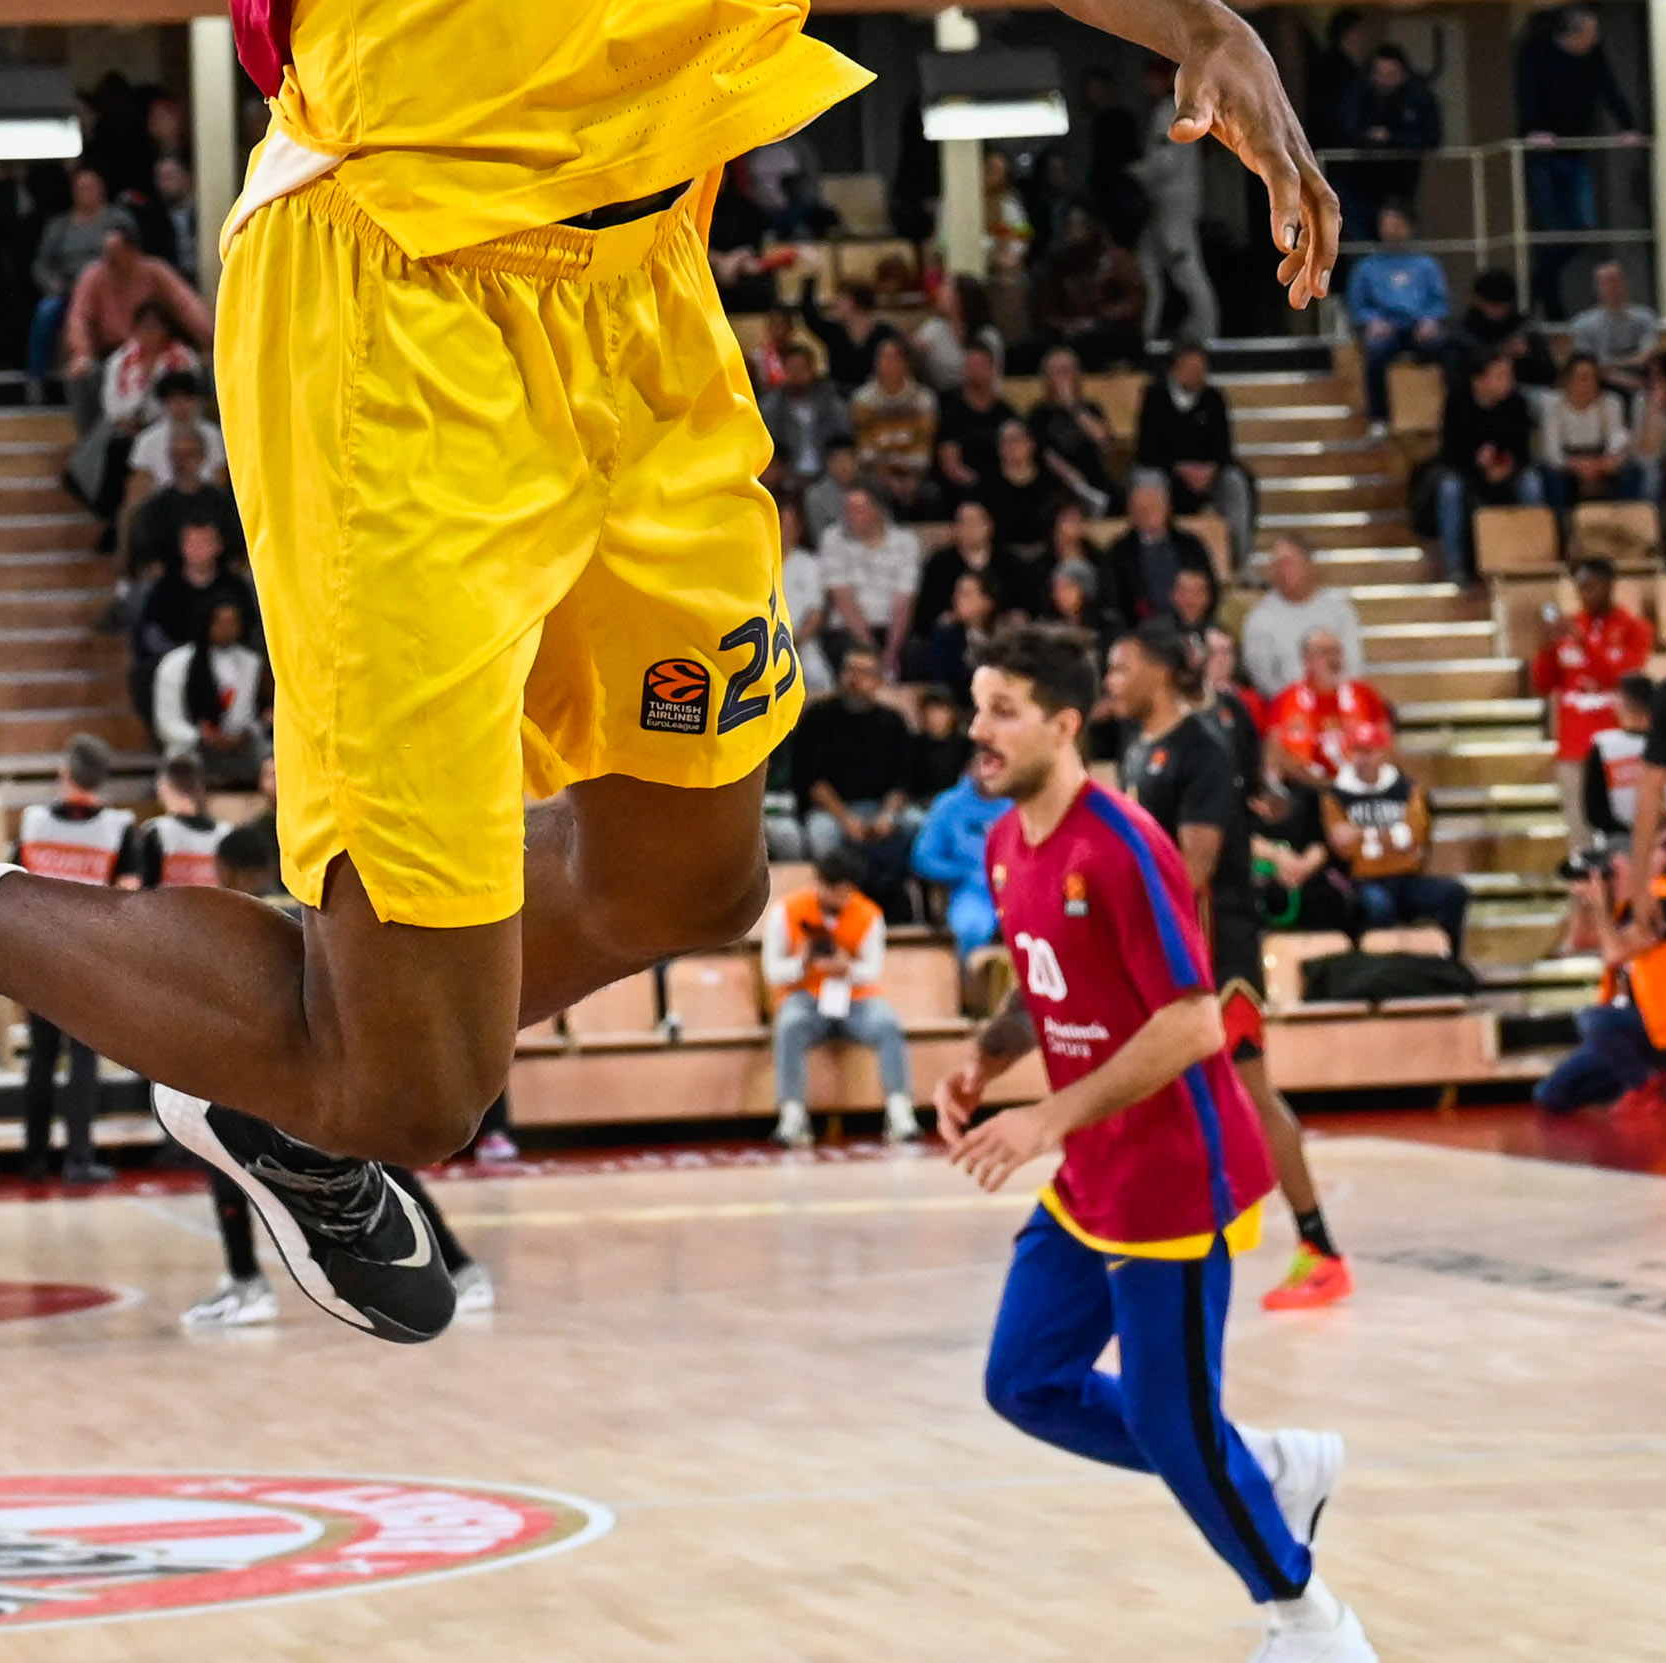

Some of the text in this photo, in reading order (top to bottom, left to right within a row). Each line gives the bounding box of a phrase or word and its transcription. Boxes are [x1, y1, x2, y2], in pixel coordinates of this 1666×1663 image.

[648, 701, 702, 714] TURKISH
[647, 710, 701, 723] AIRLINES
[646, 718, 700, 731] EuroLeague
